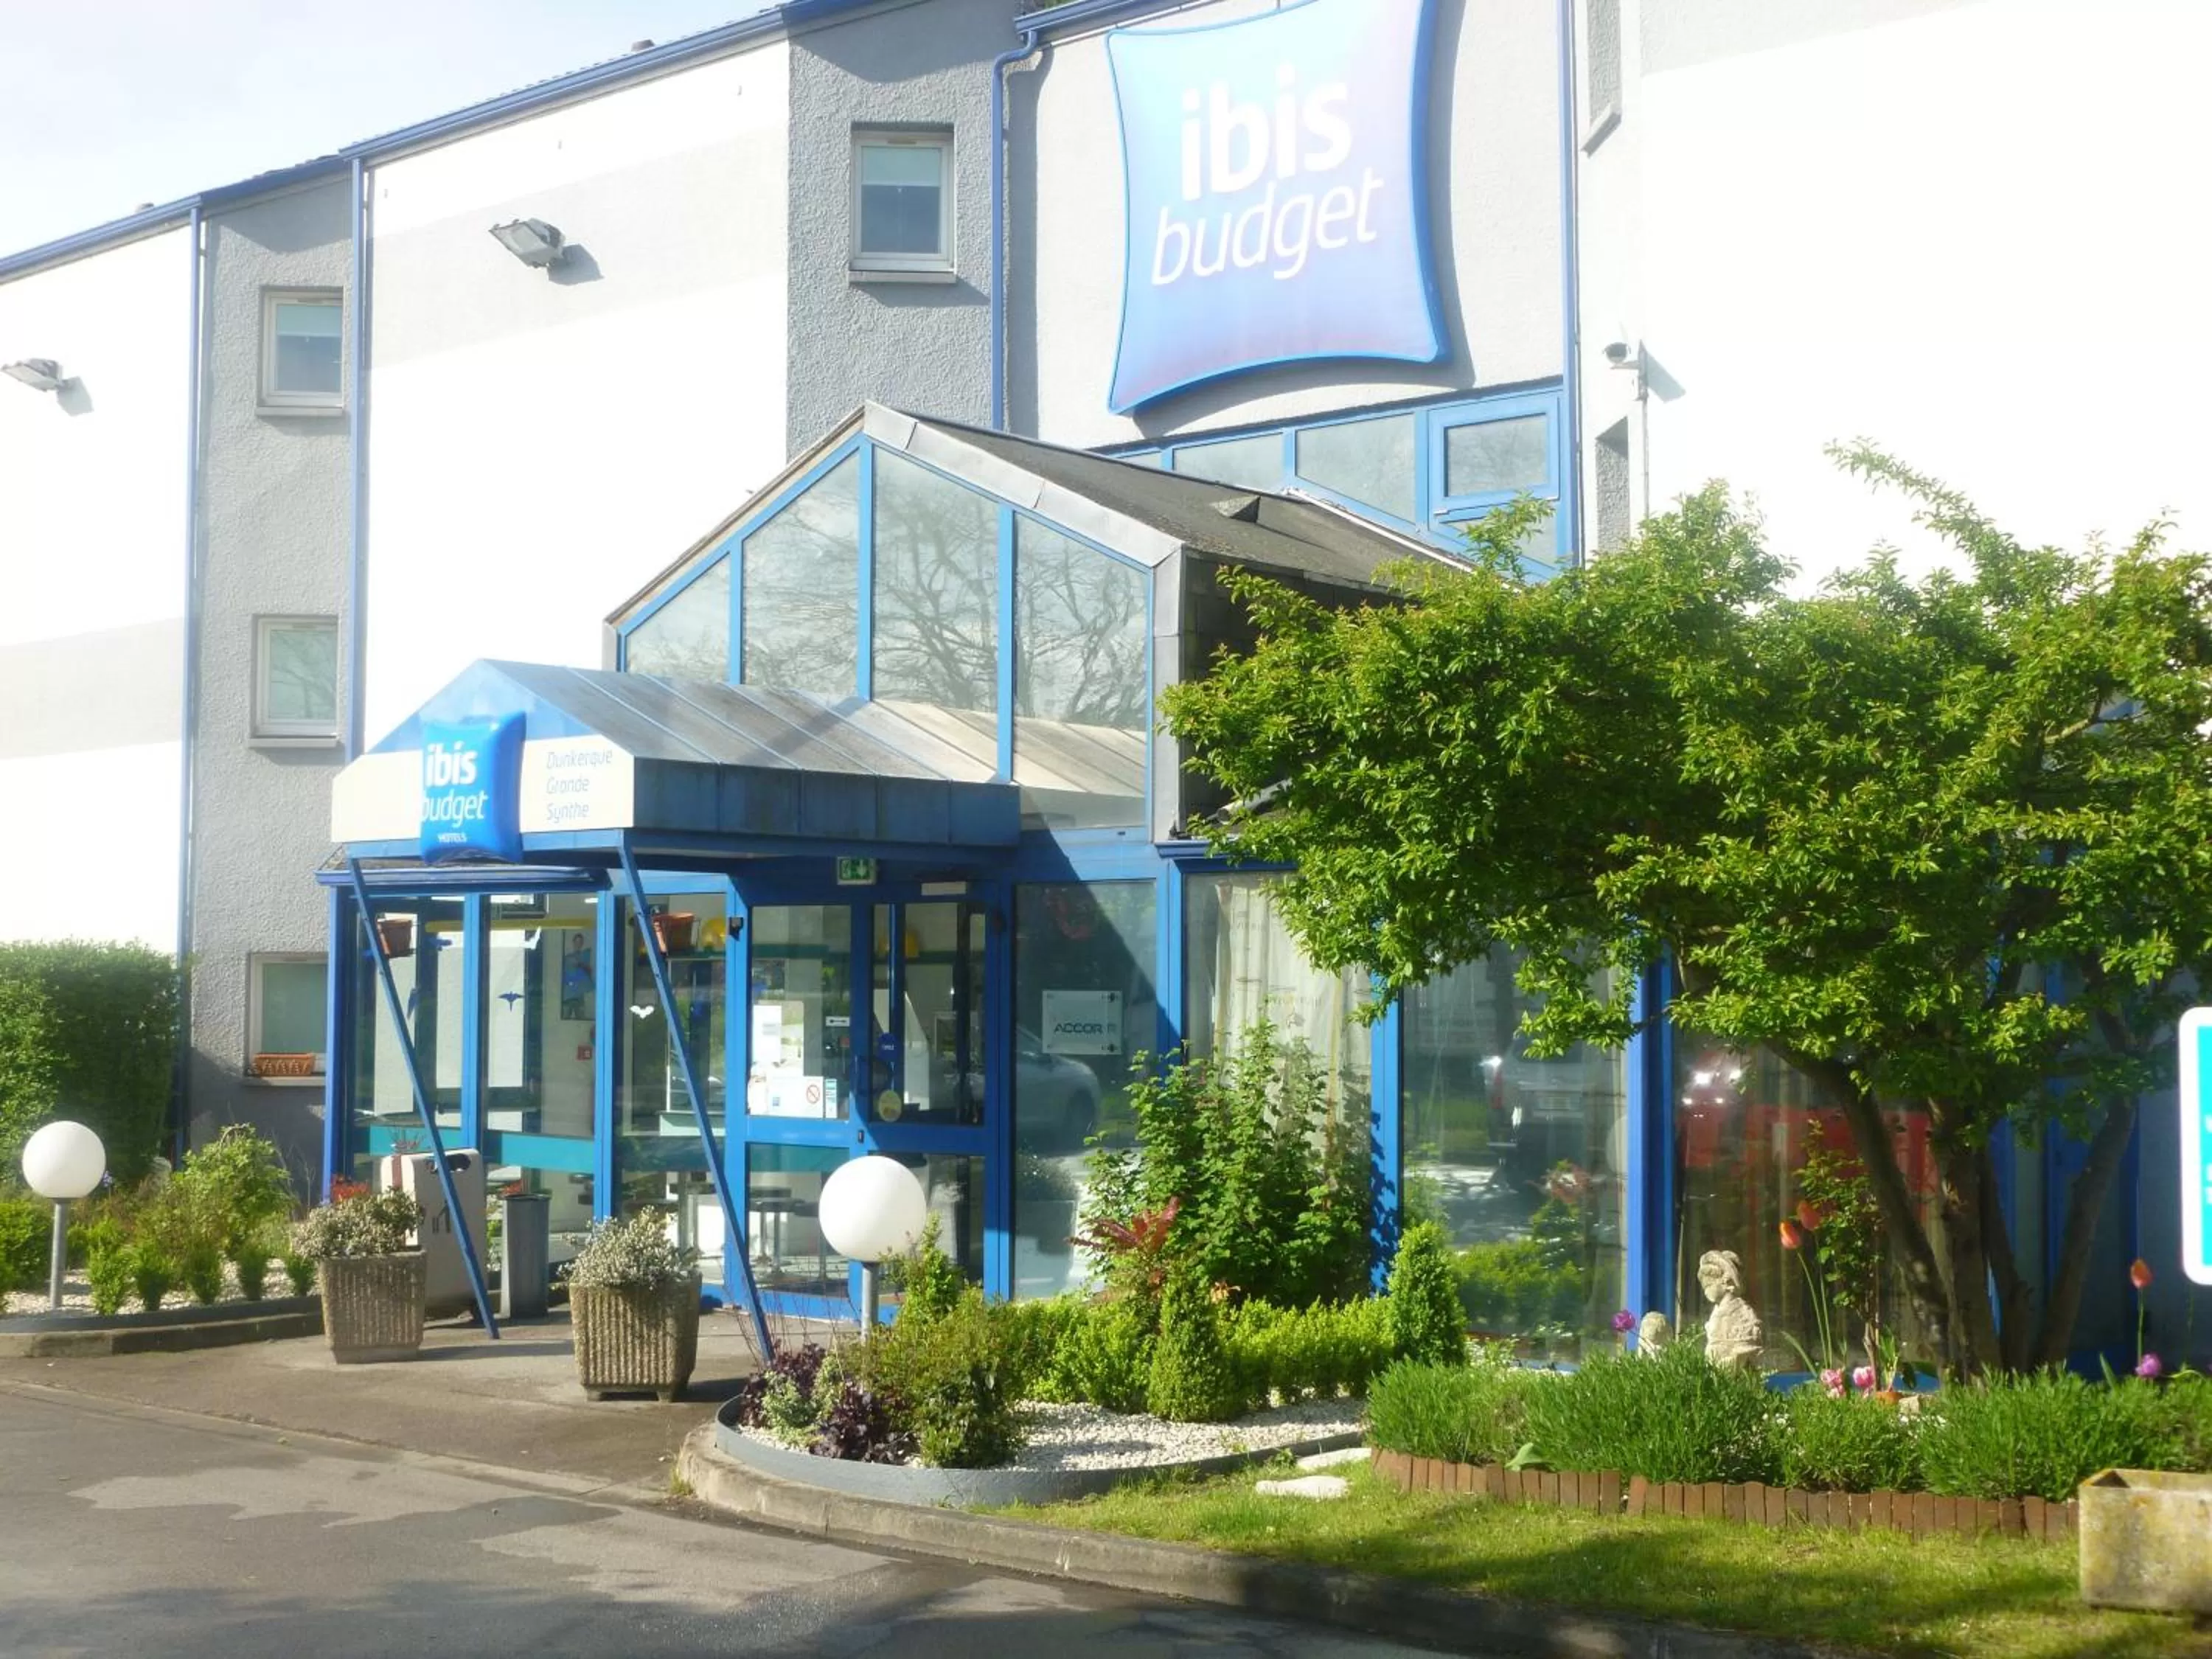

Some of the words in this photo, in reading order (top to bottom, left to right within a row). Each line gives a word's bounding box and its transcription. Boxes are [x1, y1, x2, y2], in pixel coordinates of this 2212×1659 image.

[1181, 63, 1352, 201] ibis
[1151, 167, 1385, 286] budget
[425, 740, 478, 787] ibis
[546, 749, 613, 770] Dunkerque
[546, 773, 591, 794] Grande
[420, 788, 490, 828] budget
[546, 802, 590, 824] Synthe
[1053, 1023, 1105, 1034] ACCOR
